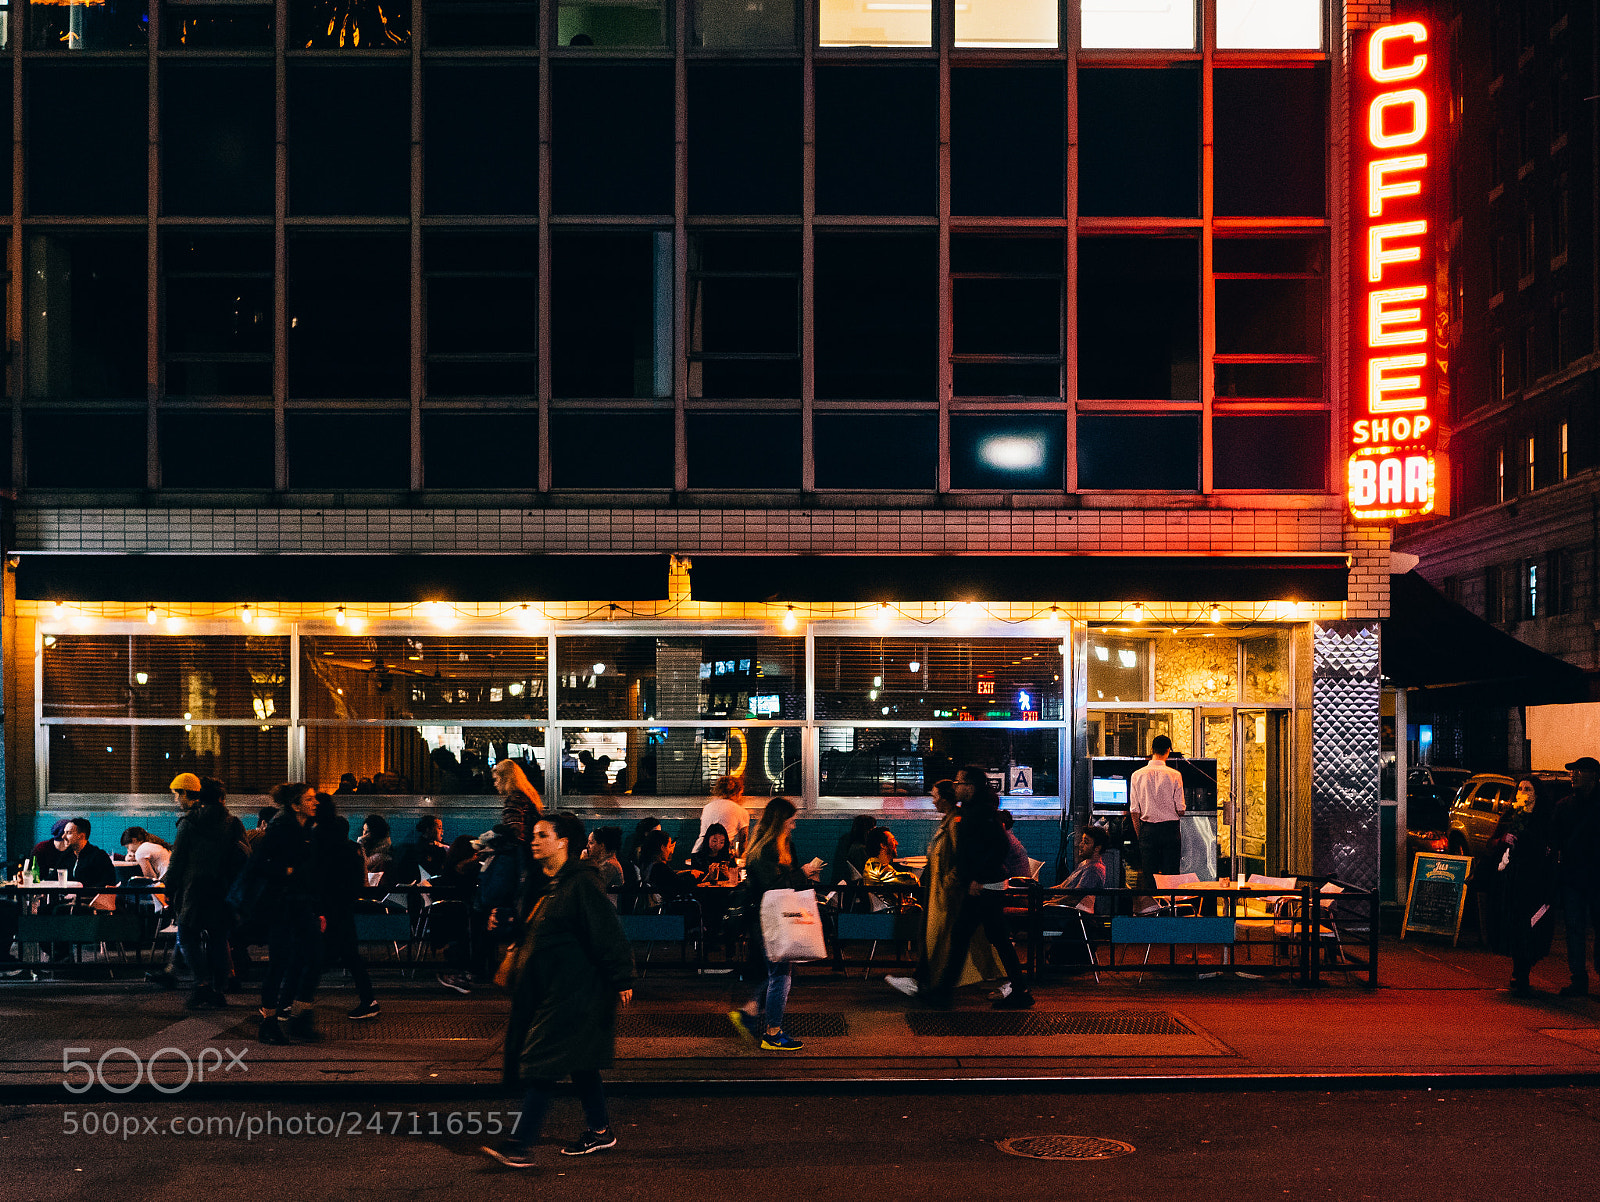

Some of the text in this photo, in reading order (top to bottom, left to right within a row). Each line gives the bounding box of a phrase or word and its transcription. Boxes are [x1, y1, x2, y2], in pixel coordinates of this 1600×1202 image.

[1368, 21, 1428, 414] COFFEE
[1352, 415, 1431, 444] SHOP
[1354, 456, 1428, 506] BAR
[977, 681, 995, 694] EXIT
[1014, 770, 1029, 788] A
